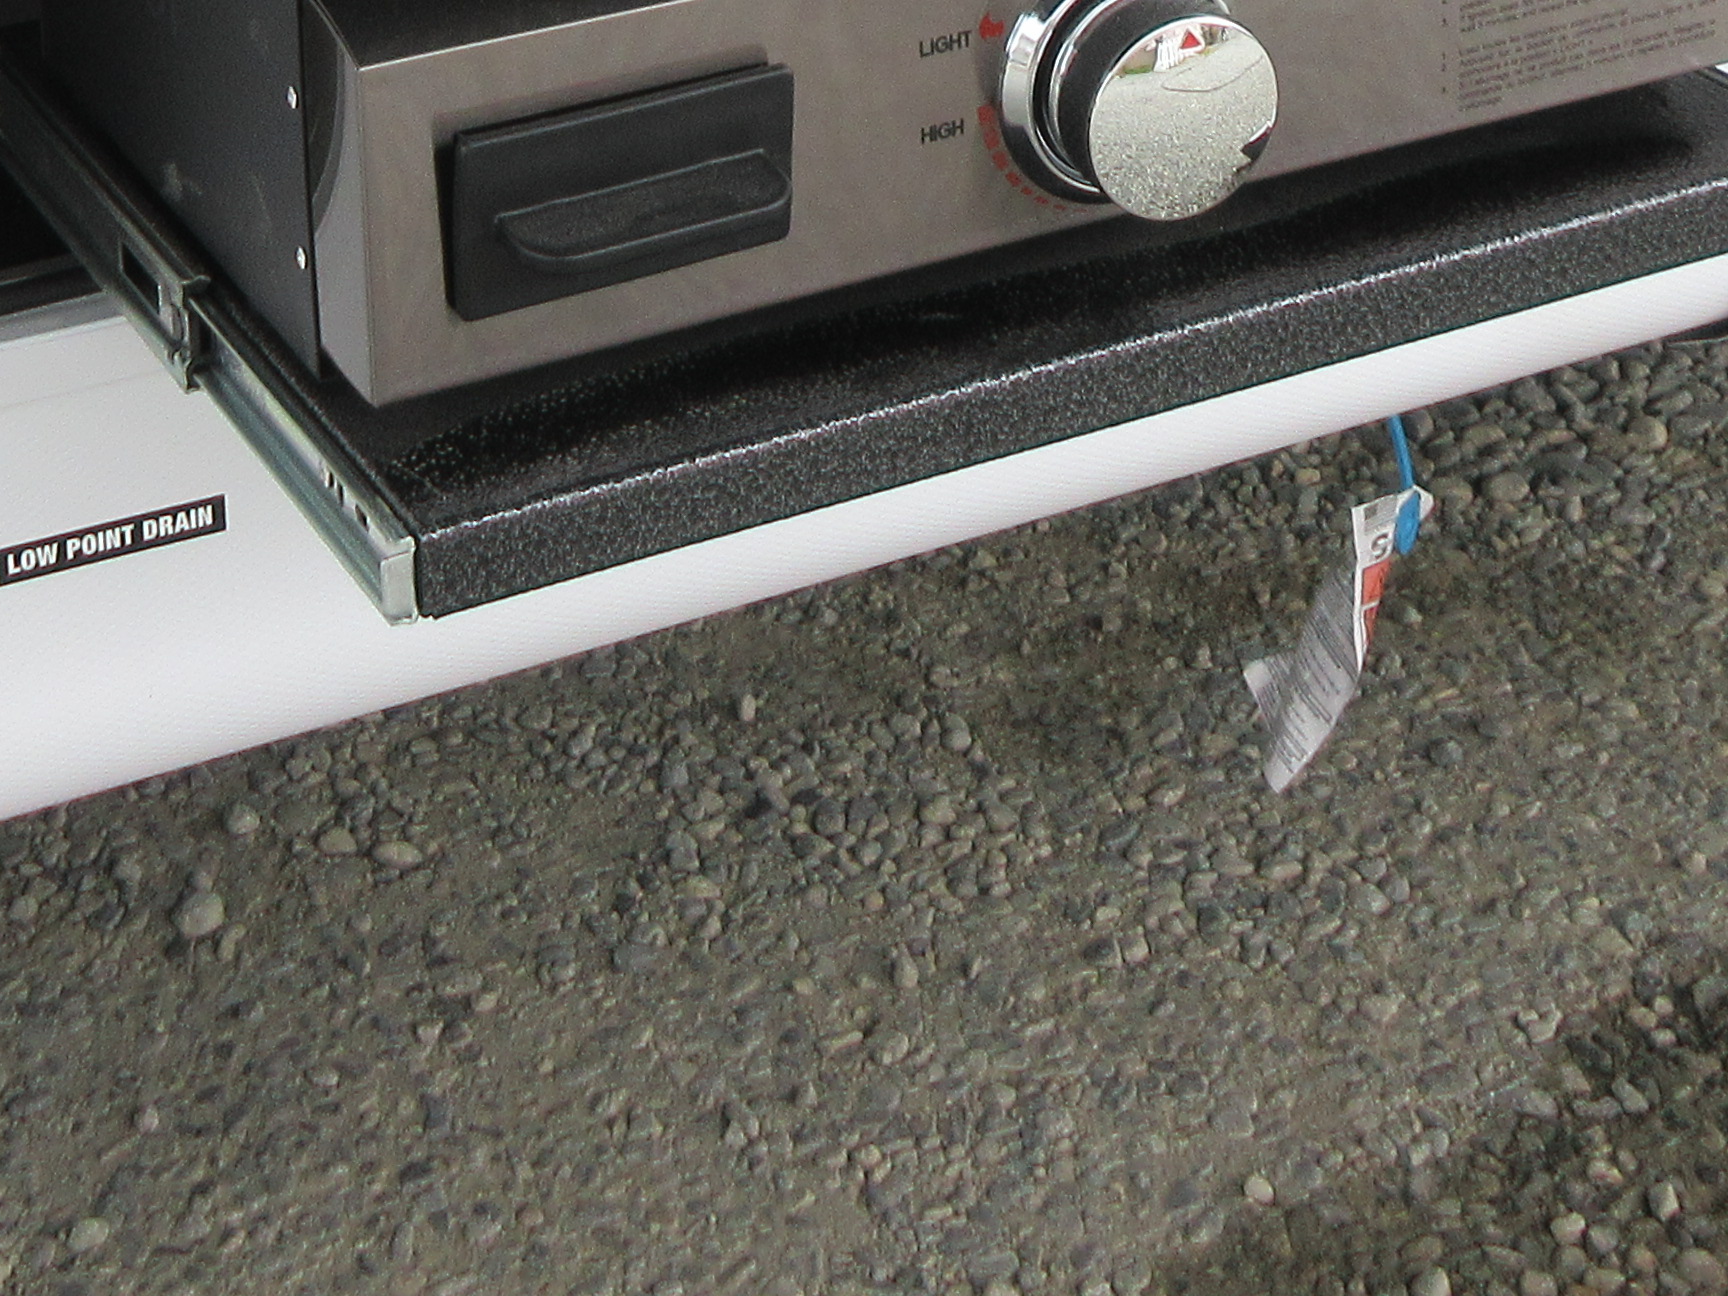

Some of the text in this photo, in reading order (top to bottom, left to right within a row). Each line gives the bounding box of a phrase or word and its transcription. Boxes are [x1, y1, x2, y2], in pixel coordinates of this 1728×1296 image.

[920, 30, 972, 59] LIGHT
[921, 118, 964, 145] HIGH
[6, 504, 214, 576] LOW POINT DRAIN
